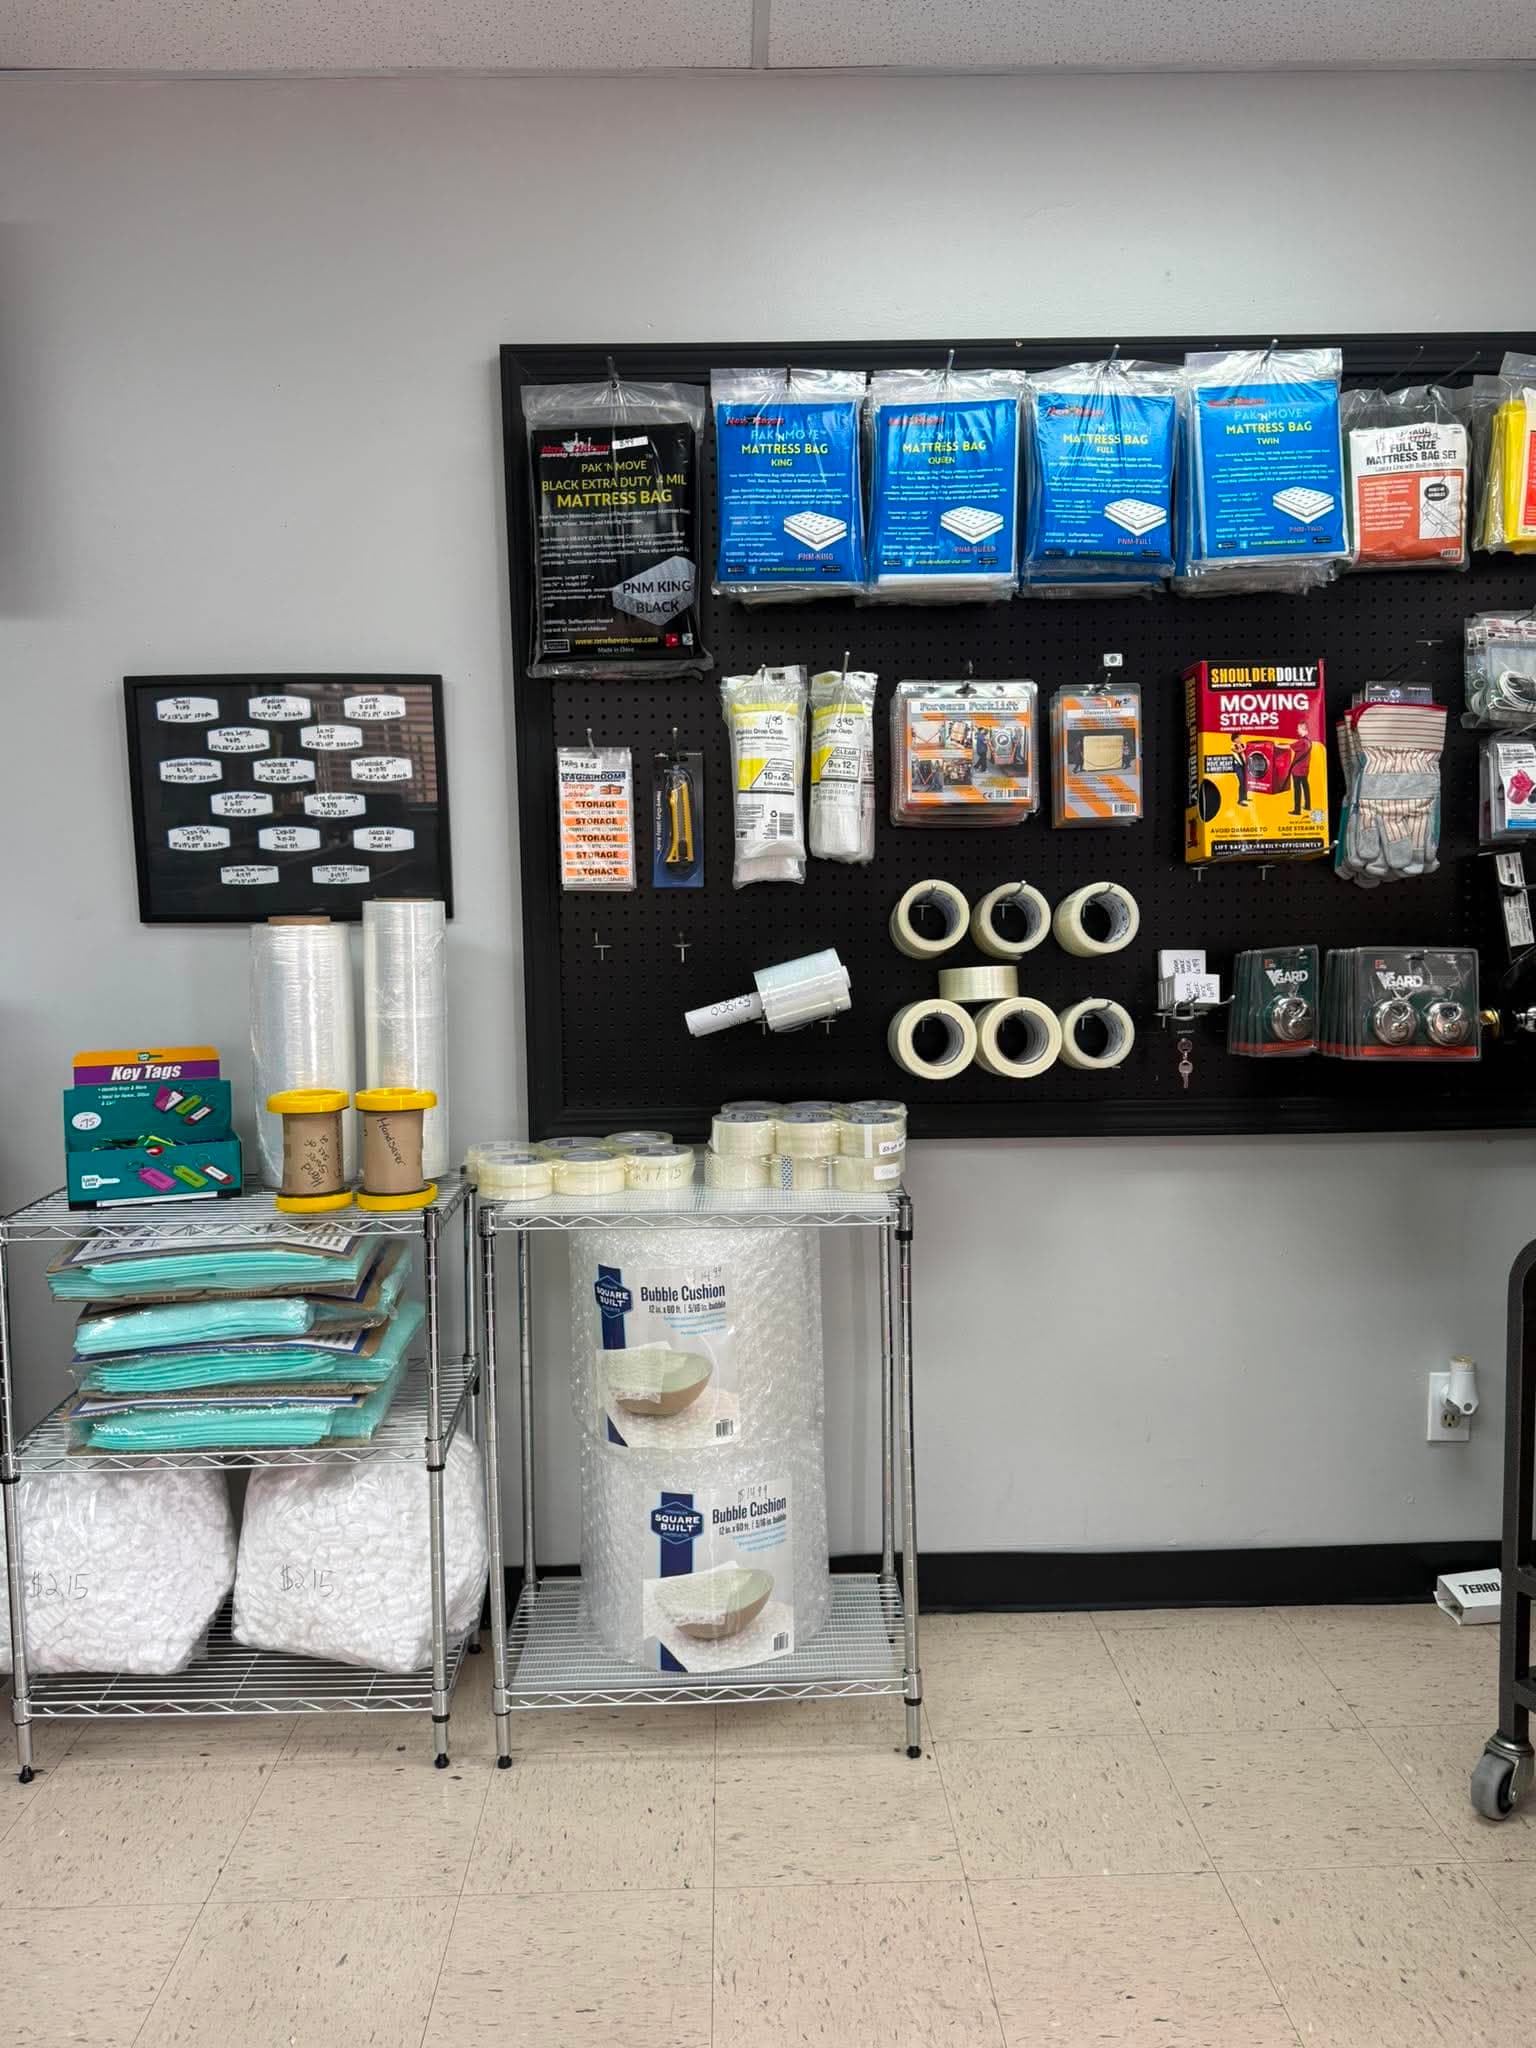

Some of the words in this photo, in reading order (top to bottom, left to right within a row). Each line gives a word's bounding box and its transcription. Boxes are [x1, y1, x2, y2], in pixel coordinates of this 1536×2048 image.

[1226, 422, 1285, 435] MATTRESS
[1288, 421, 1313, 432] BAG
[1063, 434, 1121, 445] MATTRESS
[1123, 434, 1149, 445] BAG
[1256, 437, 1280, 445] TWIN
[741, 443, 801, 454] MATTRESS
[804, 444, 828, 455] BAG
[902, 442, 959, 454] MATTRESS
[962, 440, 987, 452] BAG
[1096, 446, 1115, 454] FULL
[1391, 442, 1414, 453] FULL
[1416, 440, 1437, 451] SIZE
[771, 458, 793, 467] KING
[927, 456, 956, 465] QUEEN
[1366, 453, 1418, 465] MATTRESS
[1421, 450, 1440, 461] BAG
[1442, 450, 1457, 460] SET
[581, 463, 601, 473] PAK
[614, 460, 648, 471] MOVE
[541, 480, 579, 492] BLACK
[581, 478, 618, 490] EXTRA
[620, 475, 652, 487] DUTY
[666, 473, 687, 486] MIL
[557, 491, 637, 509] MATTRESS
[640, 489, 673, 504] BAG
[623, 582, 654, 595] PNM
[657, 580, 692, 593] KING
[636, 601, 680, 614] BLACK
[1211, 666, 1314, 683] SHOULDERDOLLY
[1220, 694, 1309, 712] MOVING
[1220, 712, 1279, 726] STRAPS
[828, 760, 834, 768] 9
[842, 761, 852, 769] 12
[575, 800, 617, 808] STORAGE
[575, 817, 618, 825] STORAGE
[575, 834, 618, 842] STORAGE
[576, 850, 619, 859] STORAGE
[576, 867, 619, 876] STORAGE
[111, 1066, 142, 1081] Key
[145, 1064, 182, 1080] Tags
[597, 1287, 630, 1300] SQUARE
[641, 1286, 679, 1302] Bubble
[681, 1284, 726, 1301] Cushion
[599, 1296, 625, 1308] BUILT
[708, 1301, 726, 1311] bubble
[712, 1504, 748, 1525] Bubble
[750, 1497, 787, 1517] Cushion
[654, 1513, 701, 1524] SQUARE
[772, 1513, 787, 1524] bubble
[660, 1524, 694, 1533] BUILT
[29, 1571, 91, 1601] $2.15
[280, 1564, 342, 1599] $2.15
[1458, 1582, 1501, 1594] TERRO
